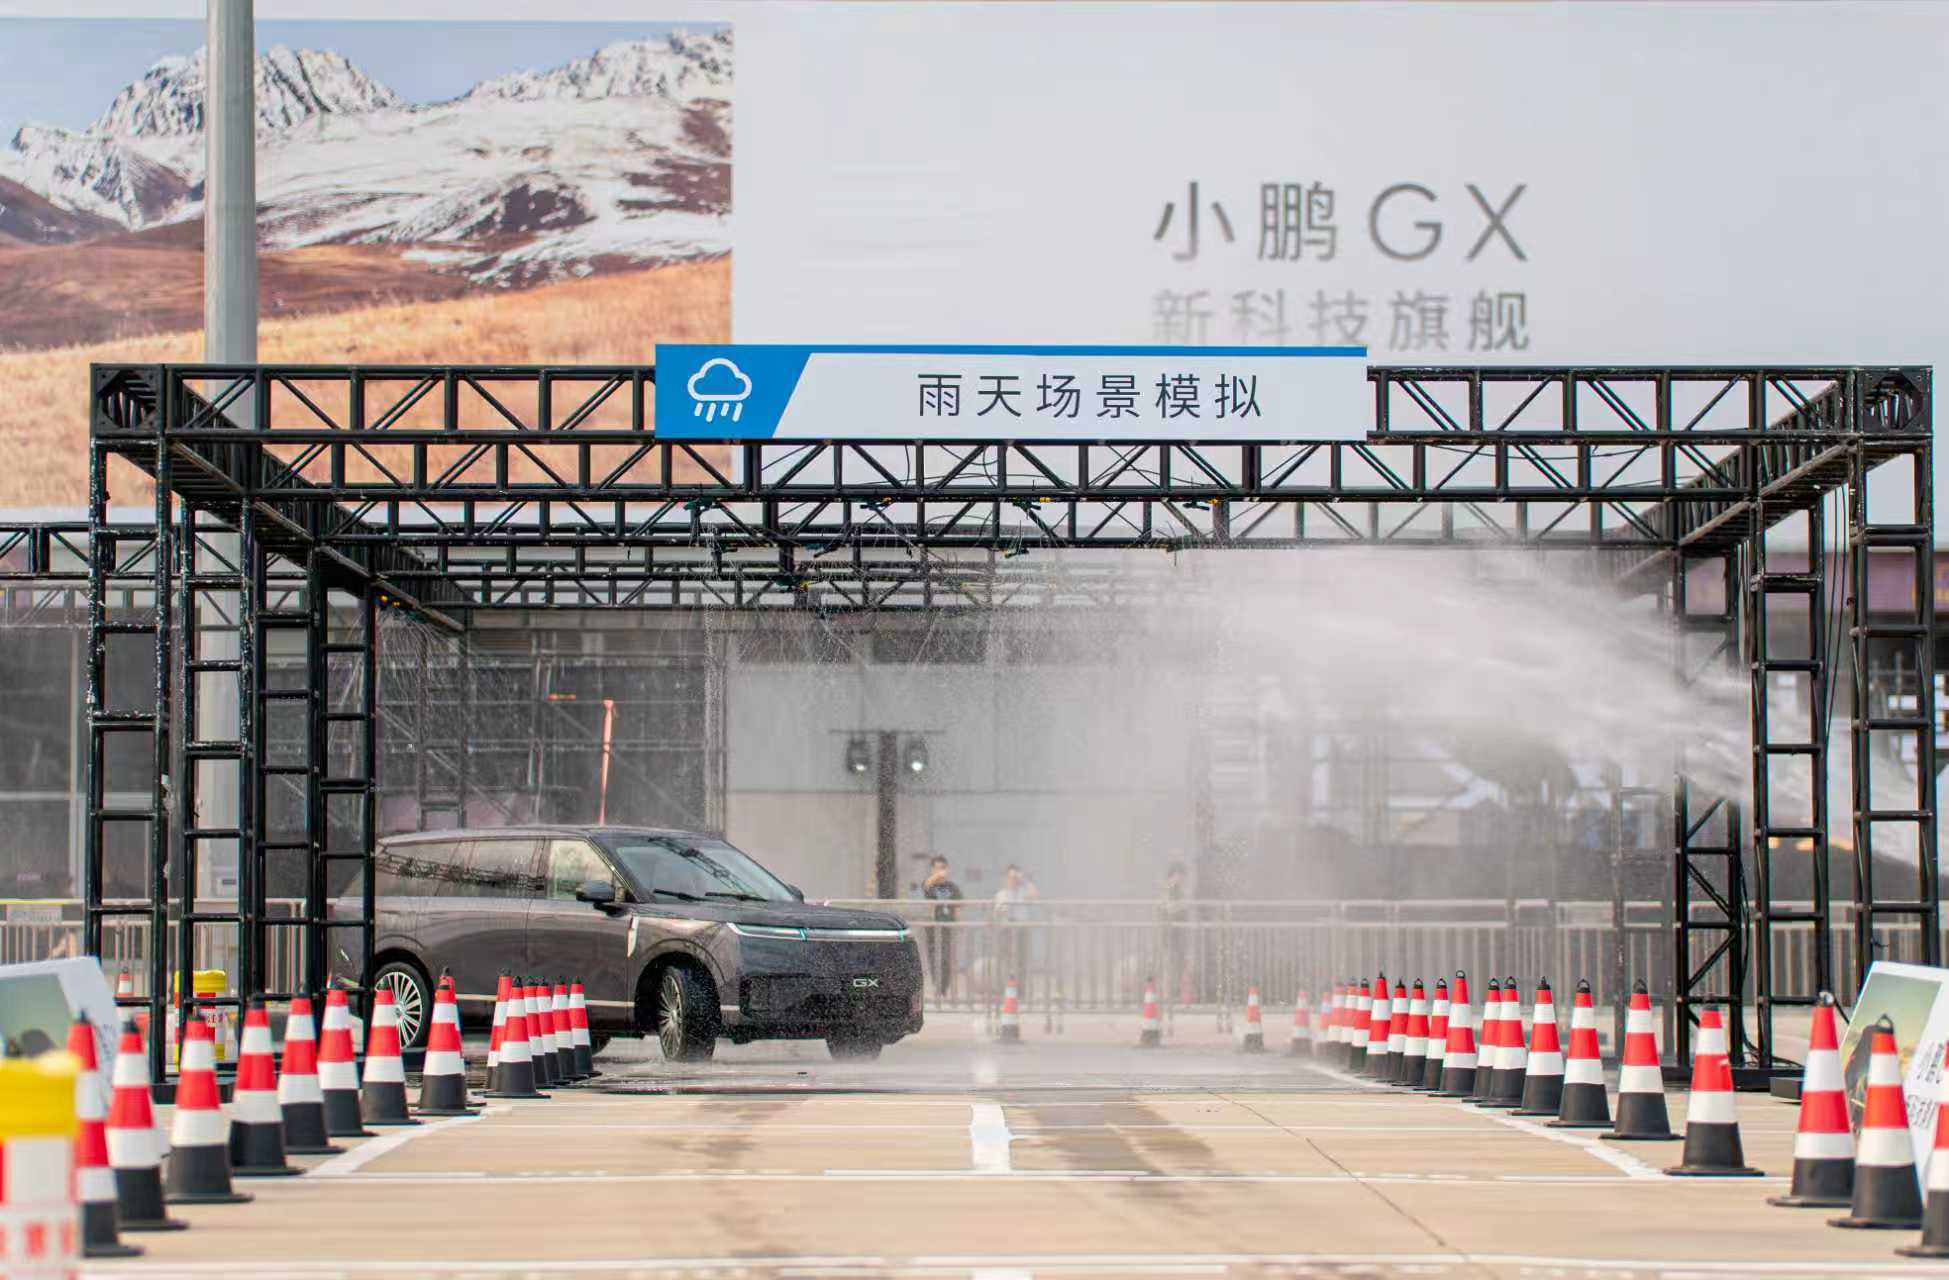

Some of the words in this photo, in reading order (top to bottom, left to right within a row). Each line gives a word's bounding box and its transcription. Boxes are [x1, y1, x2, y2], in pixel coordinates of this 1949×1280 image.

[1151, 288, 1530, 352] 新科技旗舰
[917, 373, 1262, 419] 雨天场景模拟
[852, 978, 879, 988] GX
